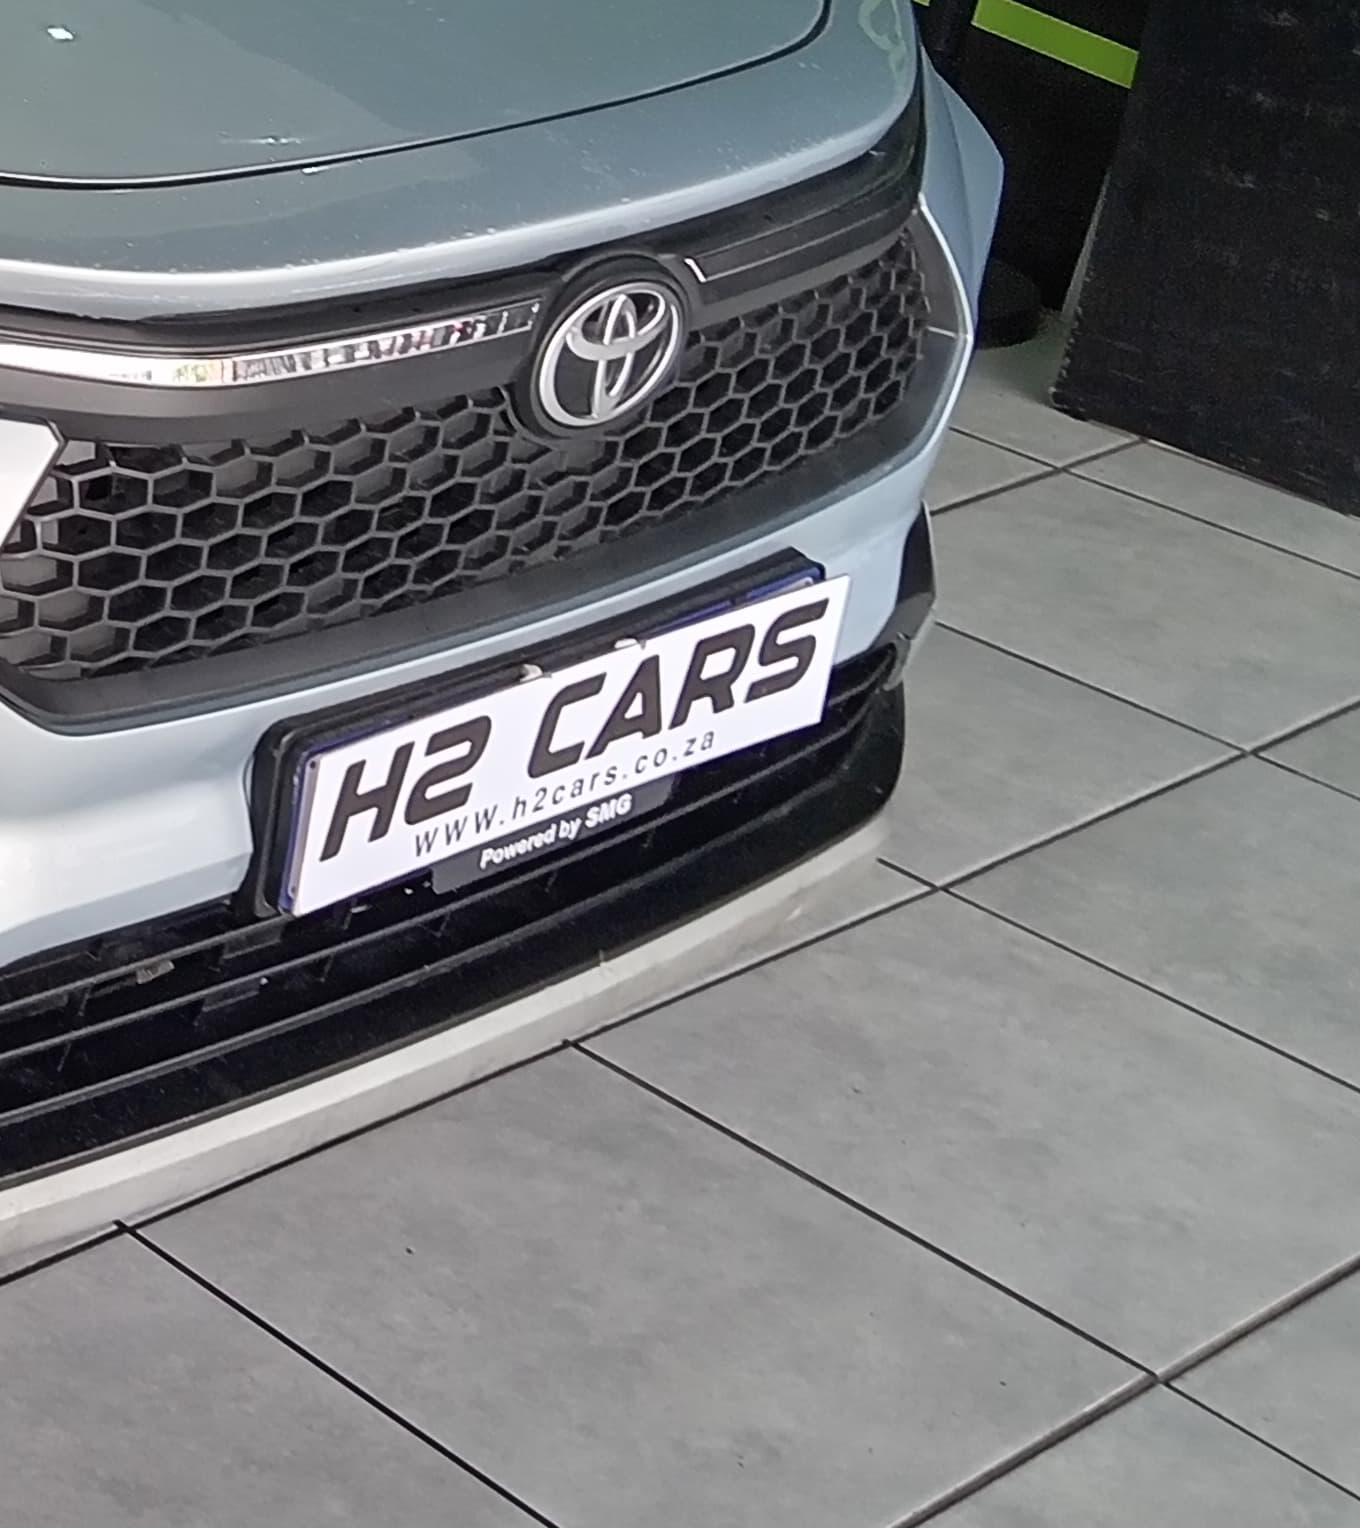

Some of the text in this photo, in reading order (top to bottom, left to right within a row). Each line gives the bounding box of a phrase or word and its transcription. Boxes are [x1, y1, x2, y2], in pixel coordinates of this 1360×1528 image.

[319, 597, 830, 863] H2 CARS
[480, 792, 633, 870] Powered by SMG
